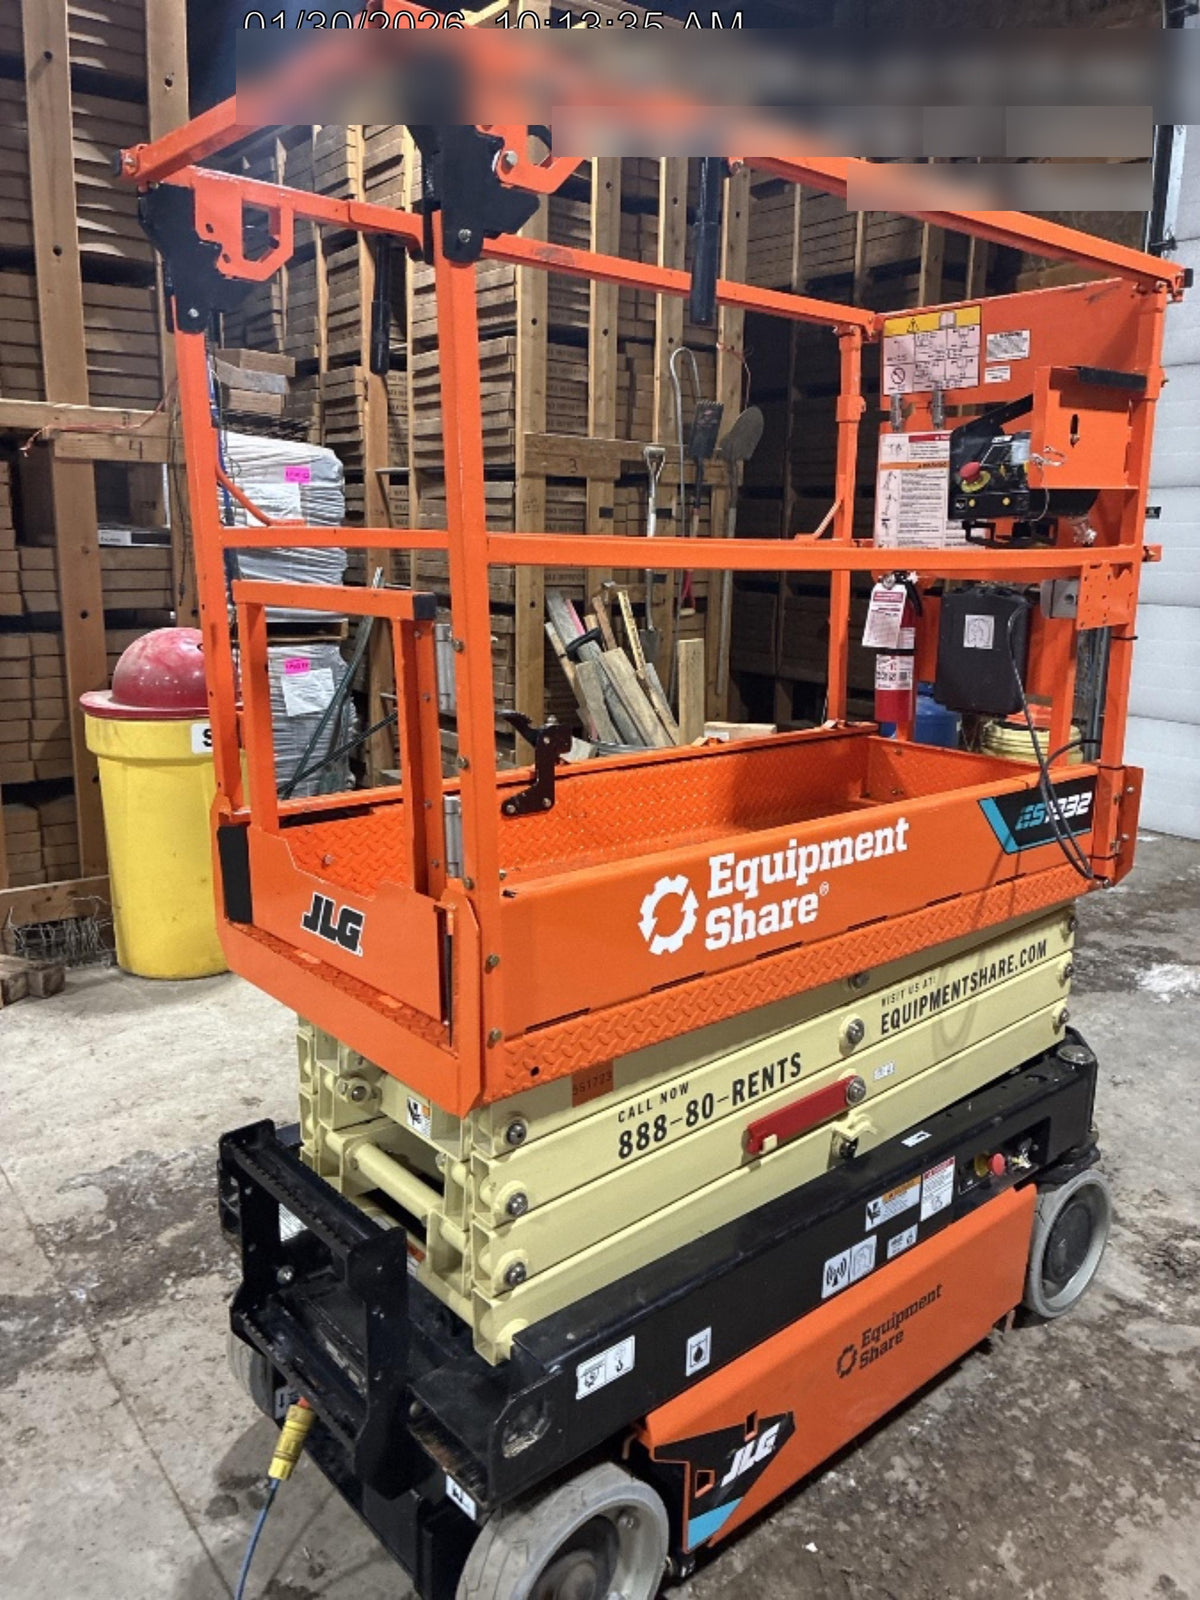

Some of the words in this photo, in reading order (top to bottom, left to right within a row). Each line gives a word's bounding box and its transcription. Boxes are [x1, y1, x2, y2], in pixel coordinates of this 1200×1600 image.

[707, 817, 909, 899] Equipment
[300, 892, 365, 956] JLG
[881, 939, 1047, 1035] EQUIPMENTSHARE.COM
[618, 1098, 653, 1123] CALL
[660, 1081, 689, 1104] NOW
[618, 1052, 801, 1159] 888-80-RENTS
[861, 1283, 943, 1349] Equipment
[859, 1330, 904, 1370] Share
[721, 1422, 780, 1487] JLG
